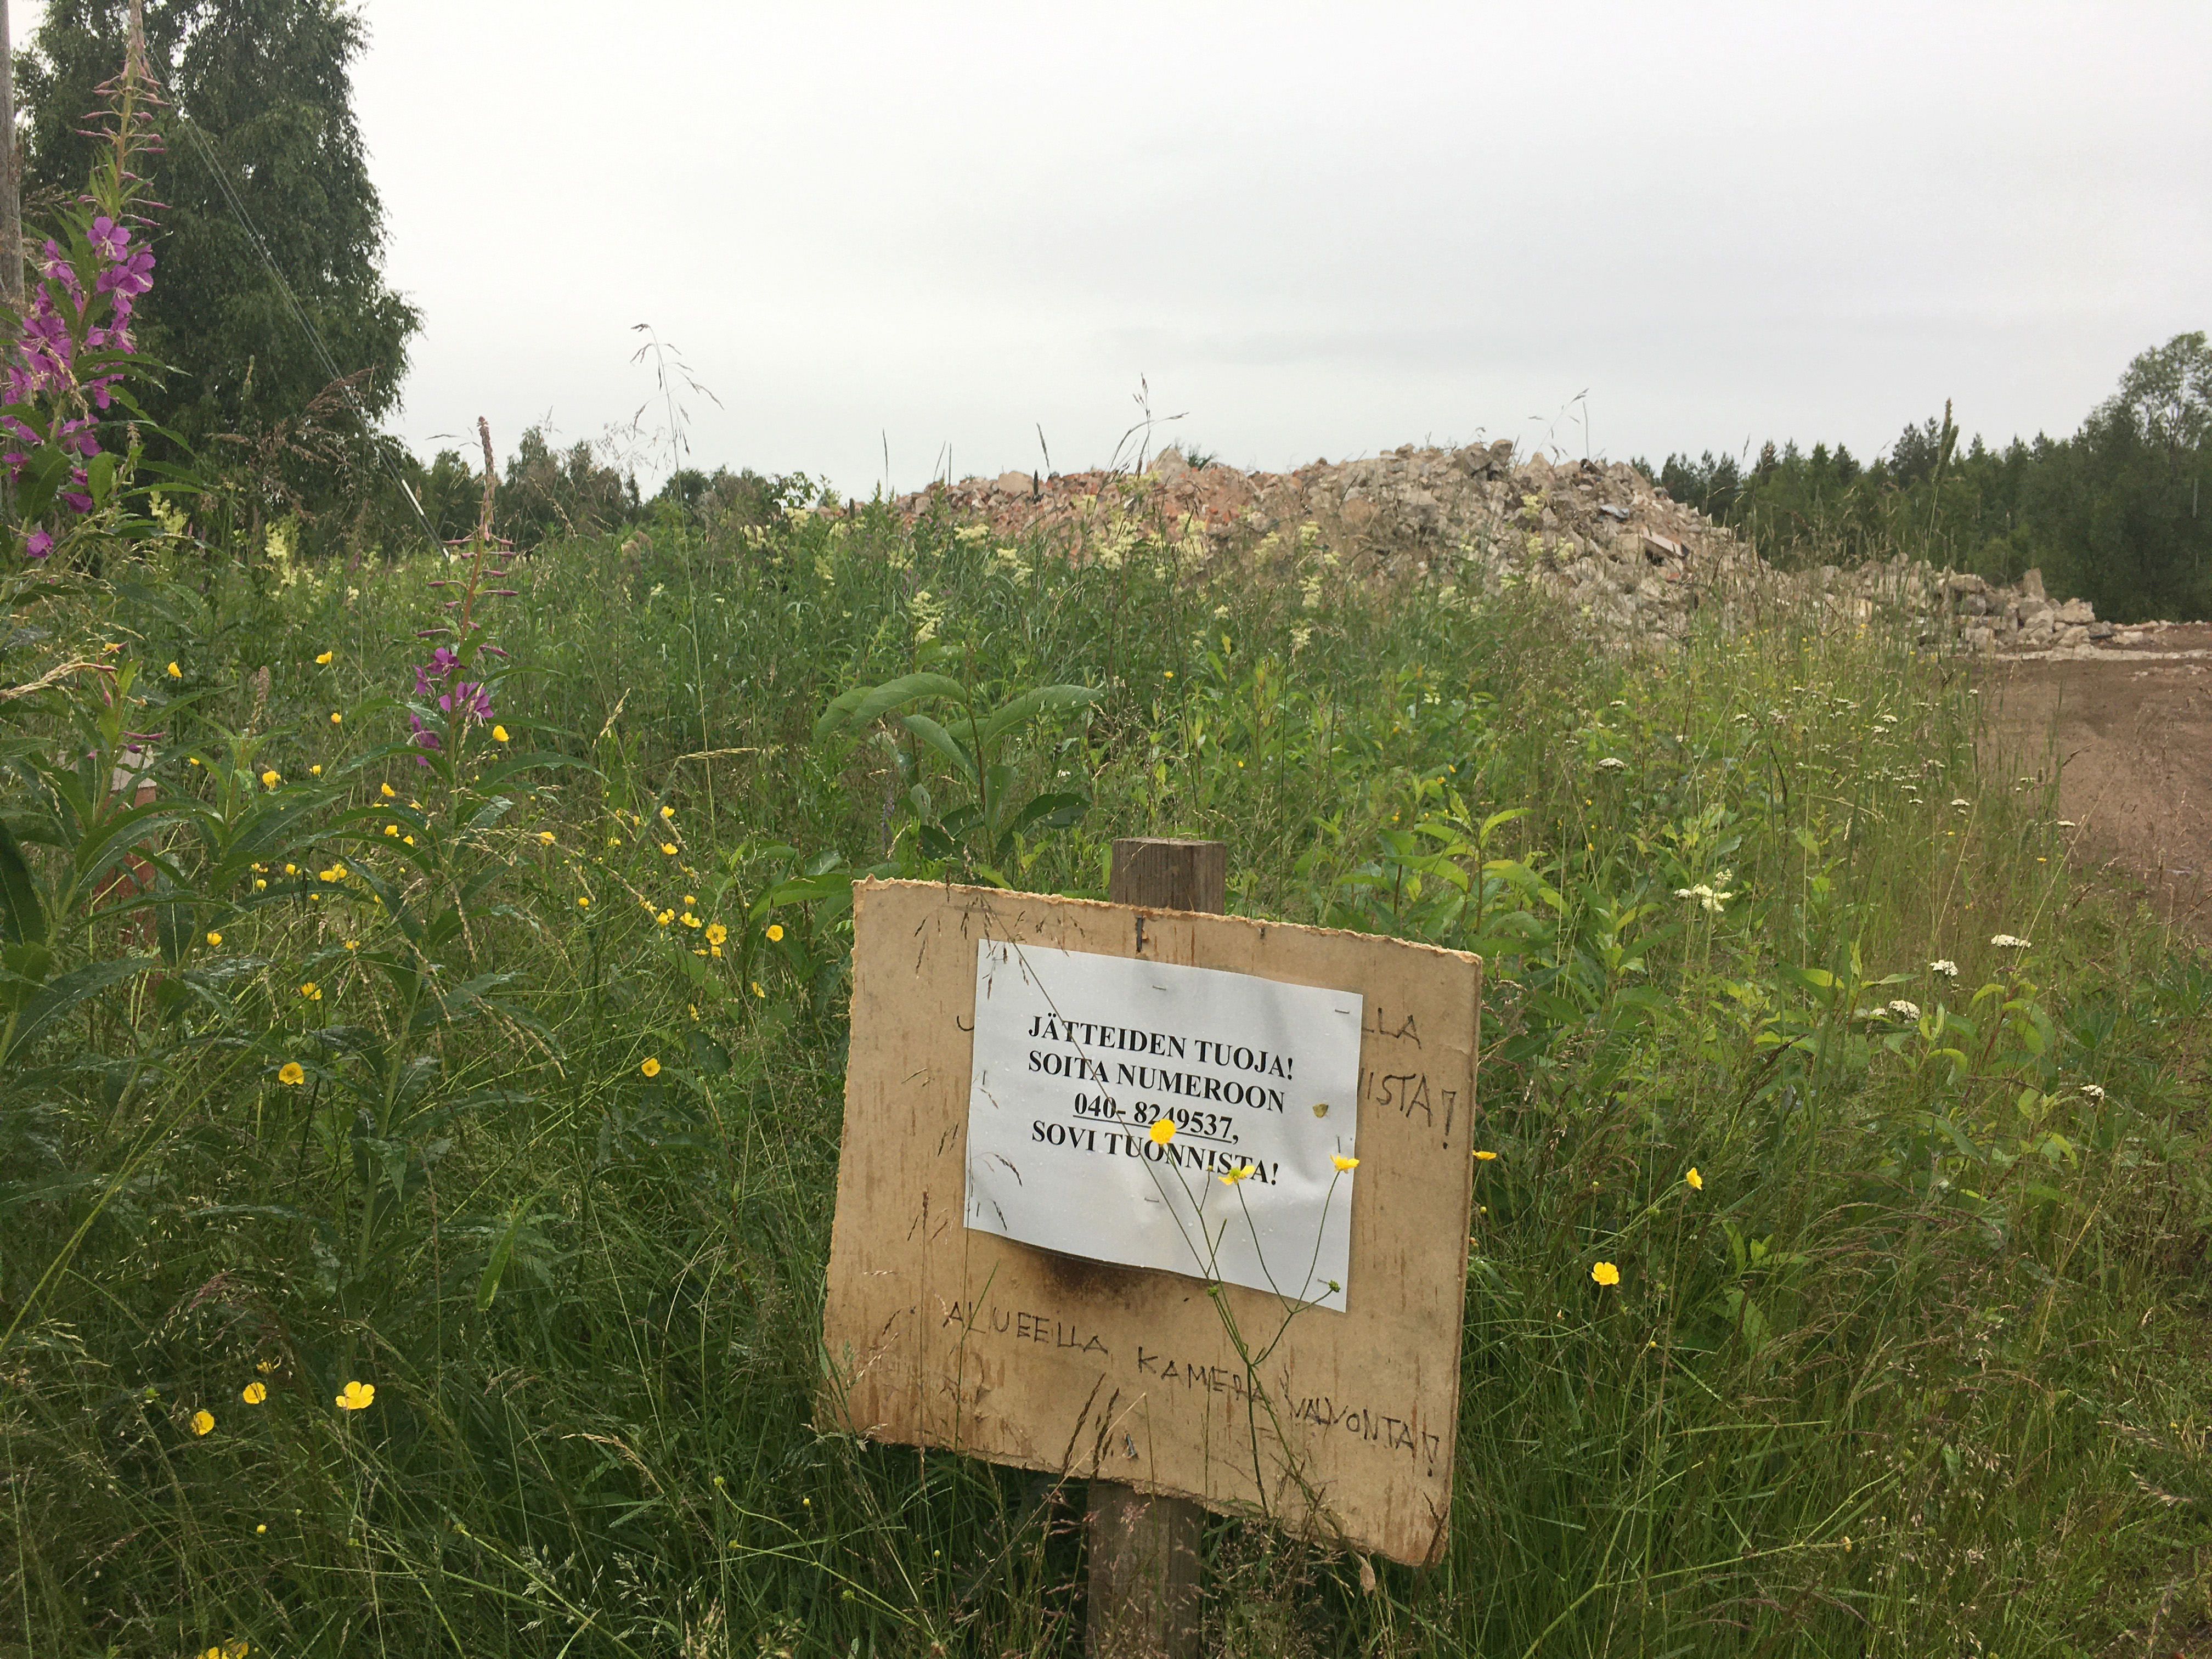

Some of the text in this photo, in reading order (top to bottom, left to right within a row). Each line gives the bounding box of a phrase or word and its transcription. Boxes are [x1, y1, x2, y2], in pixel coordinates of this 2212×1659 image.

[1028, 1012, 1294, 1080] JÄTTEIDEN TUOJA!
[1362, 1007, 1422, 1050] LA
[1028, 1050, 1285, 1114] SOITA NUMEROON
[1074, 1092, 1126, 1119] 040-
[1031, 1120, 1279, 1186] SOVI TUONNISTA!
[942, 1301, 1108, 1355] ALUEELLA
